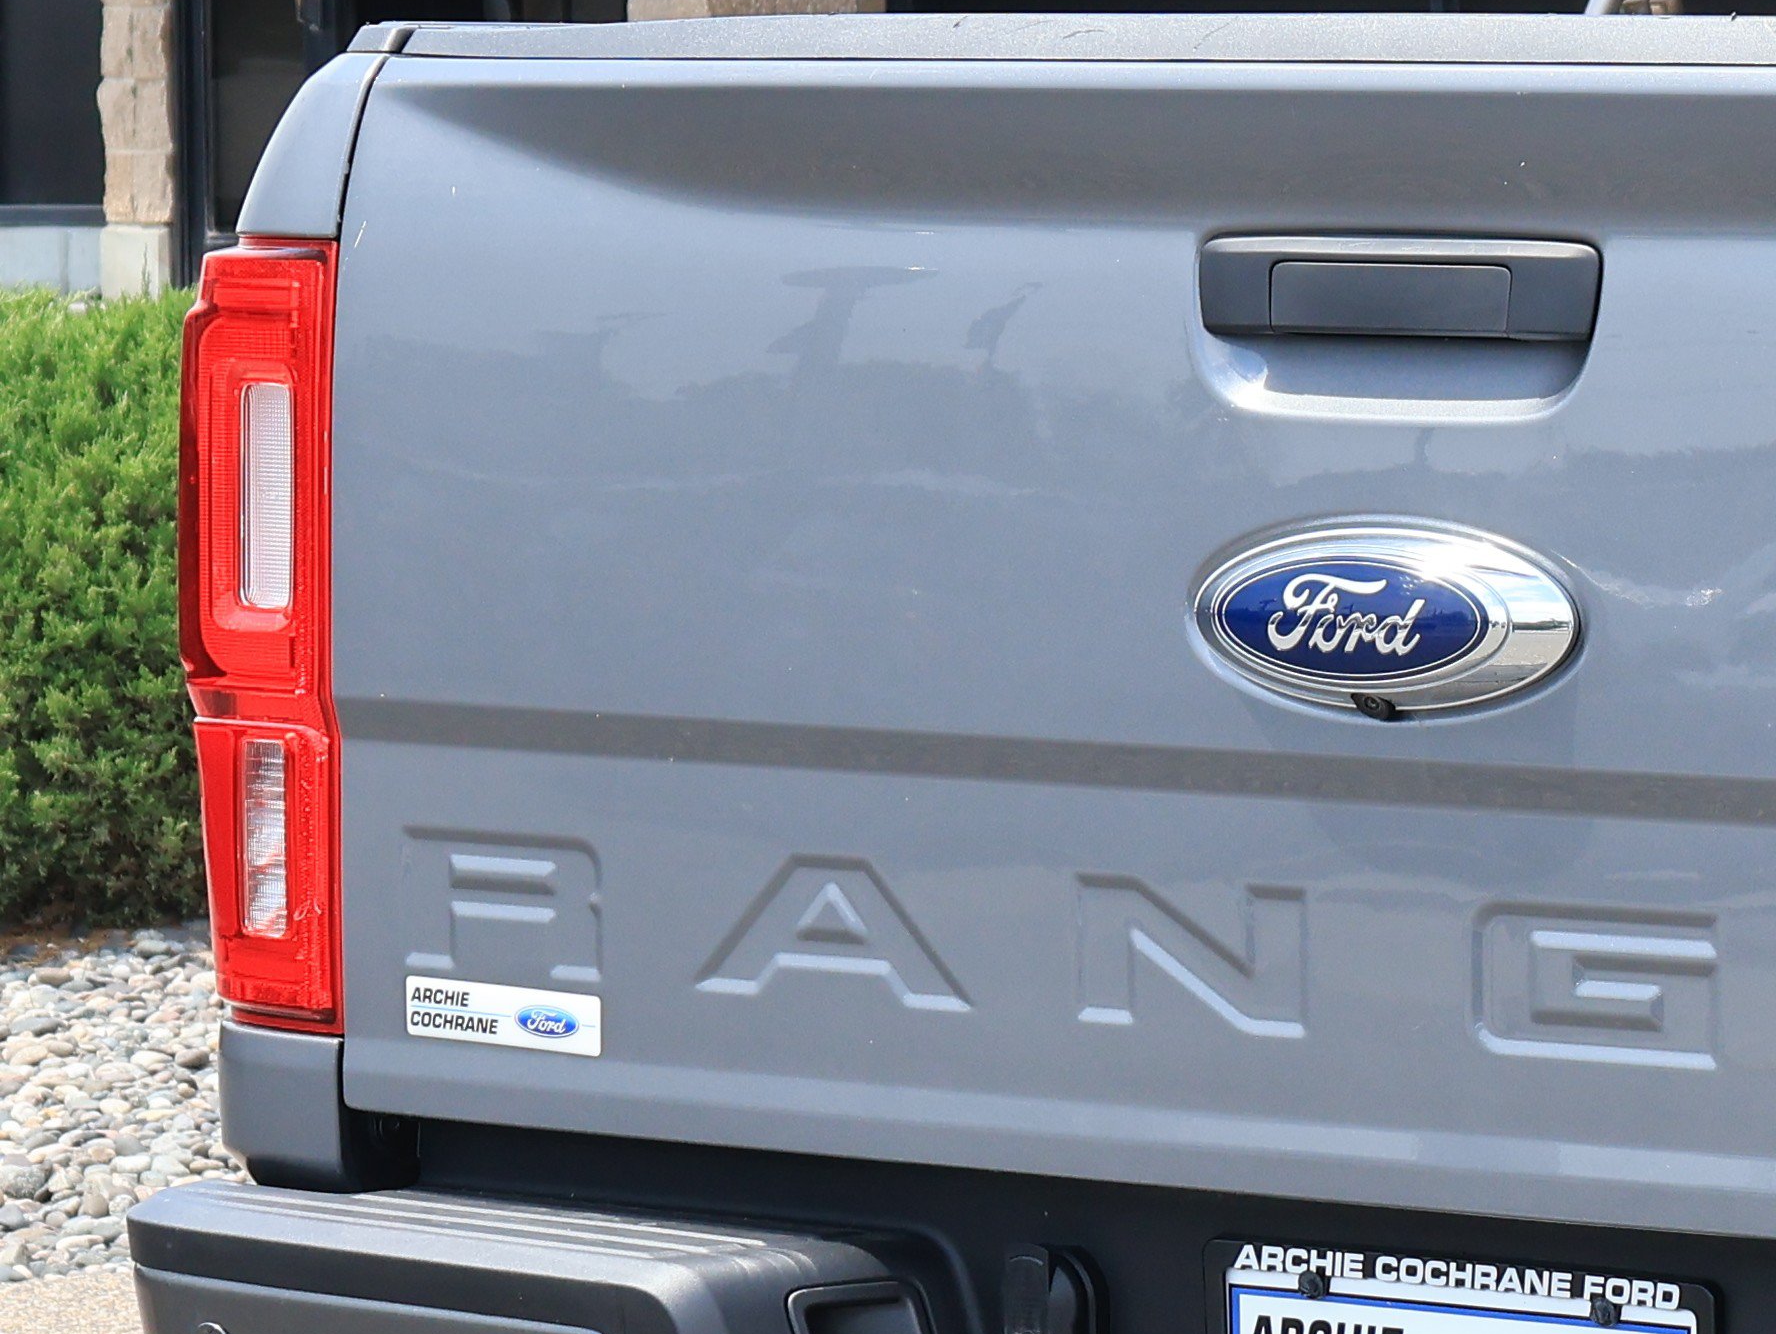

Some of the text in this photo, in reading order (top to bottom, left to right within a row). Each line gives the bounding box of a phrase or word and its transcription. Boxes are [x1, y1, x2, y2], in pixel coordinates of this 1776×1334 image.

[1267, 573, 1426, 656] Ford
[411, 986, 470, 1008] ARCHIE
[410, 1010, 499, 1035] COCHRANE
[526, 1009, 567, 1035] Ford
[1232, 1243, 1681, 1312] ARCHIE COCHRANE FORD
